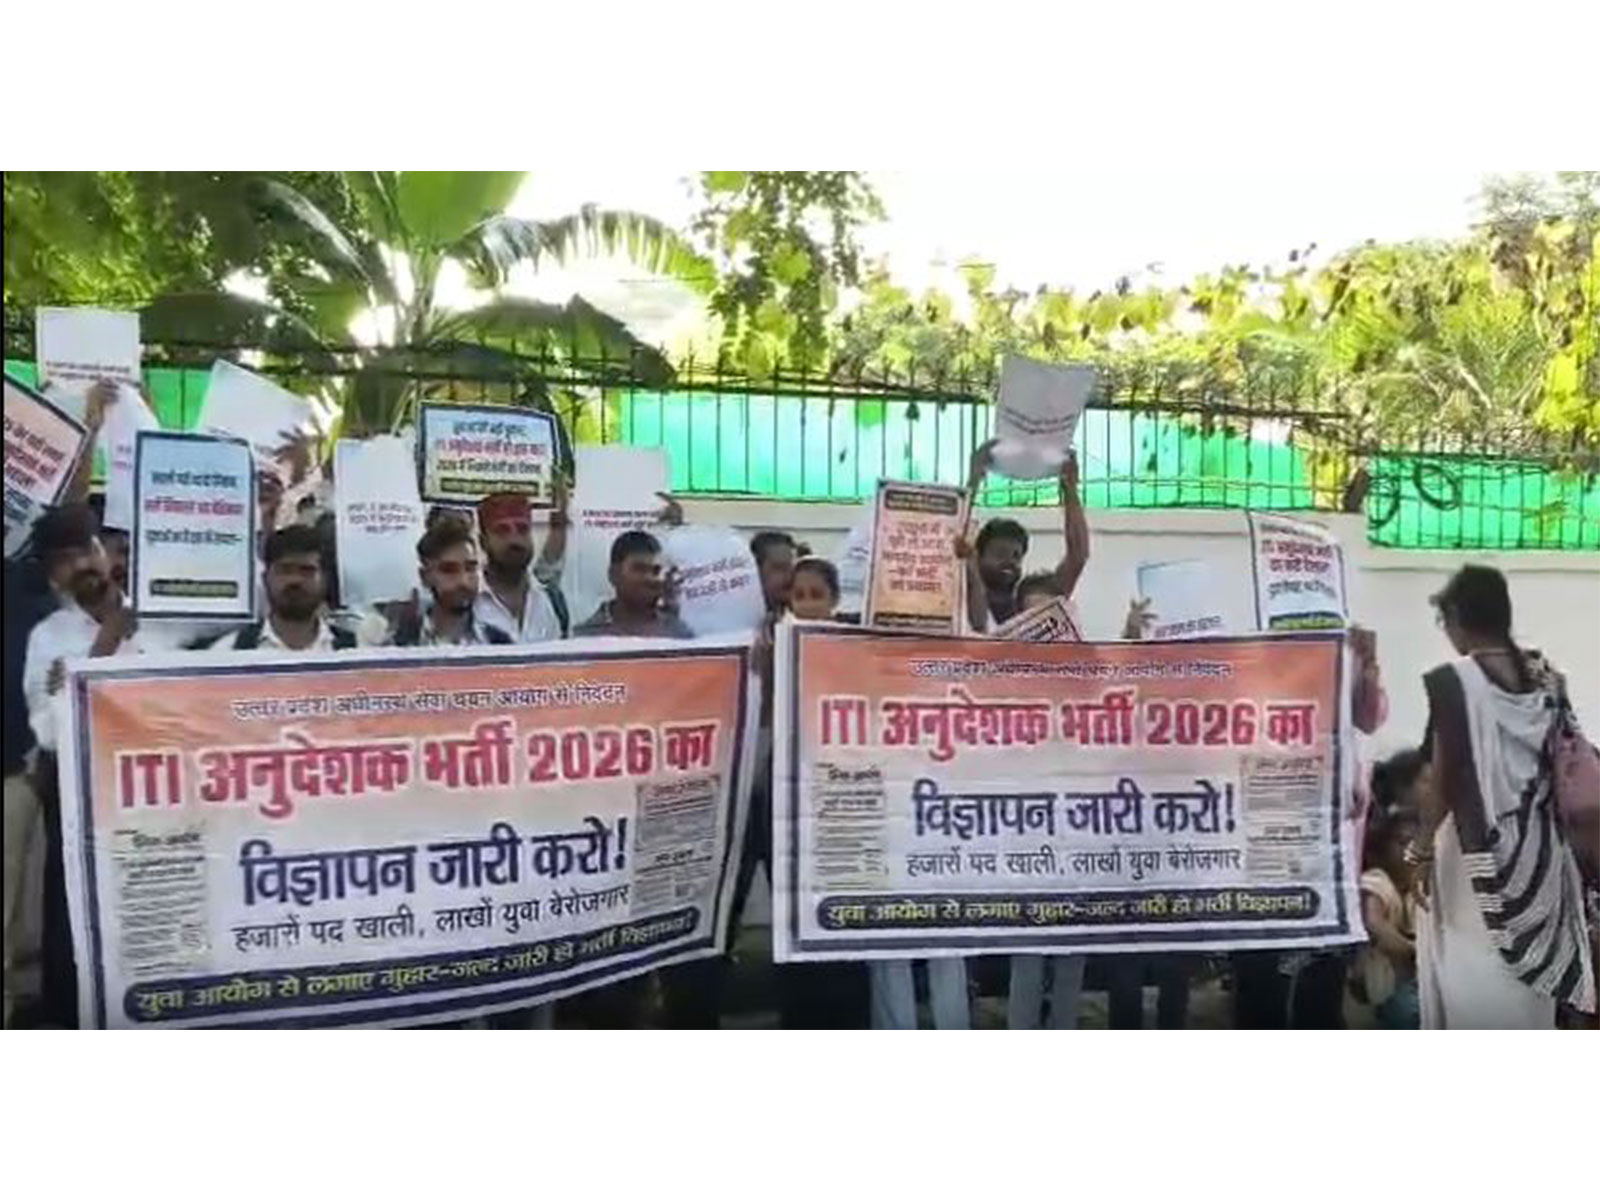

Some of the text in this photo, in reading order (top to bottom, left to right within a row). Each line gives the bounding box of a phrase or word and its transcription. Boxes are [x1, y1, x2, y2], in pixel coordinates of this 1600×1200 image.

[821, 687, 1316, 762] ITI अनुदेशक भर्ती 2026 का
[119, 720, 717, 819] ITI अनुदेशक भर्ती 2026 का
[911, 778, 1058, 840] विज्ञापन
[1064, 777, 1145, 836] जारी
[1151, 779, 1236, 835] करो!
[238, 838, 418, 907] विज्ञापन
[427, 821, 523, 889] जारी
[532, 815, 629, 881] करो!
[906, 846, 962, 877] हजारों
[968, 851, 996, 875] पद
[1071, 845, 1121, 875] लाखों
[1128, 849, 1161, 881] युवा
[1166, 846, 1242, 871] बेरोजगार
[230, 913, 301, 952] हजारों
[309, 918, 345, 944] पद
[433, 896, 493, 932] लाखों
[502, 898, 541, 934] युवा
[549, 883, 631, 916] बेरोजगार
[942, 899, 961, 919] से
[278, 974, 300, 997] से
